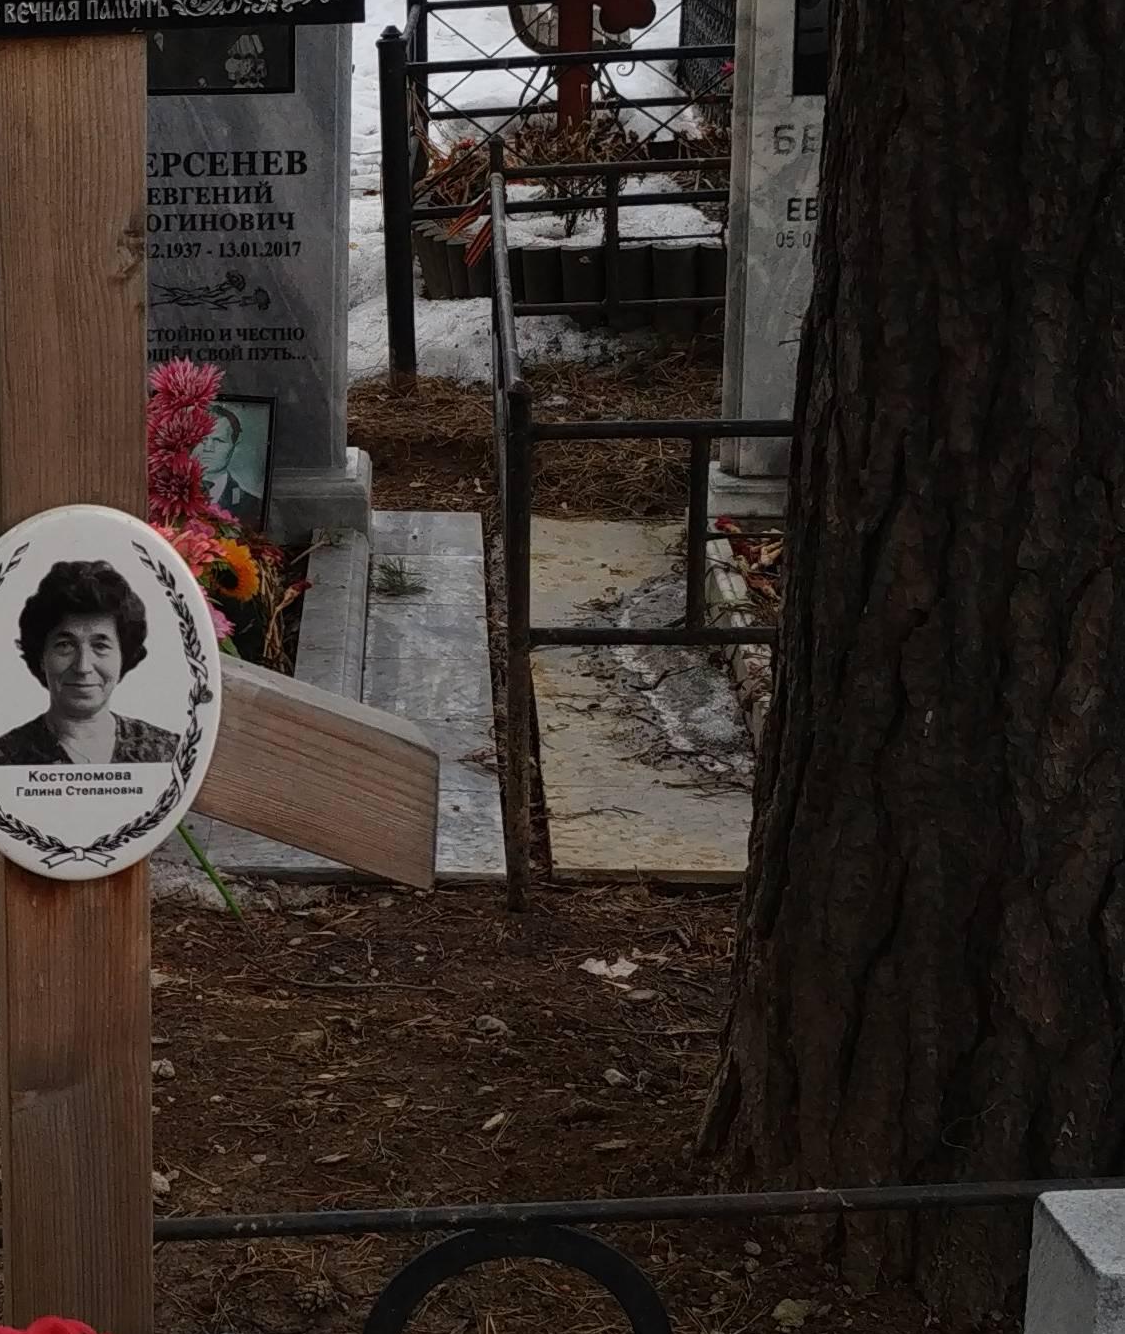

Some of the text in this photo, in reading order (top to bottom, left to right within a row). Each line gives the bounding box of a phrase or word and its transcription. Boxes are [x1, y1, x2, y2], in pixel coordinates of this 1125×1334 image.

[4, 0, 81, 24] ВЕЧНАЯ
[146, 180, 275, 206] ЕВГЕНИЙ
[146, 242, 202, 259] 2.1937
[218, 240, 303, 259] 13.01.2017
[220, 327, 232, 342] И
[236, 326, 306, 342] ЧЕСТНО
[196, 344, 243, 362] СВОЙ
[28, 770, 132, 783] Костоломова
[16, 785, 144, 797] Галина Степановна
